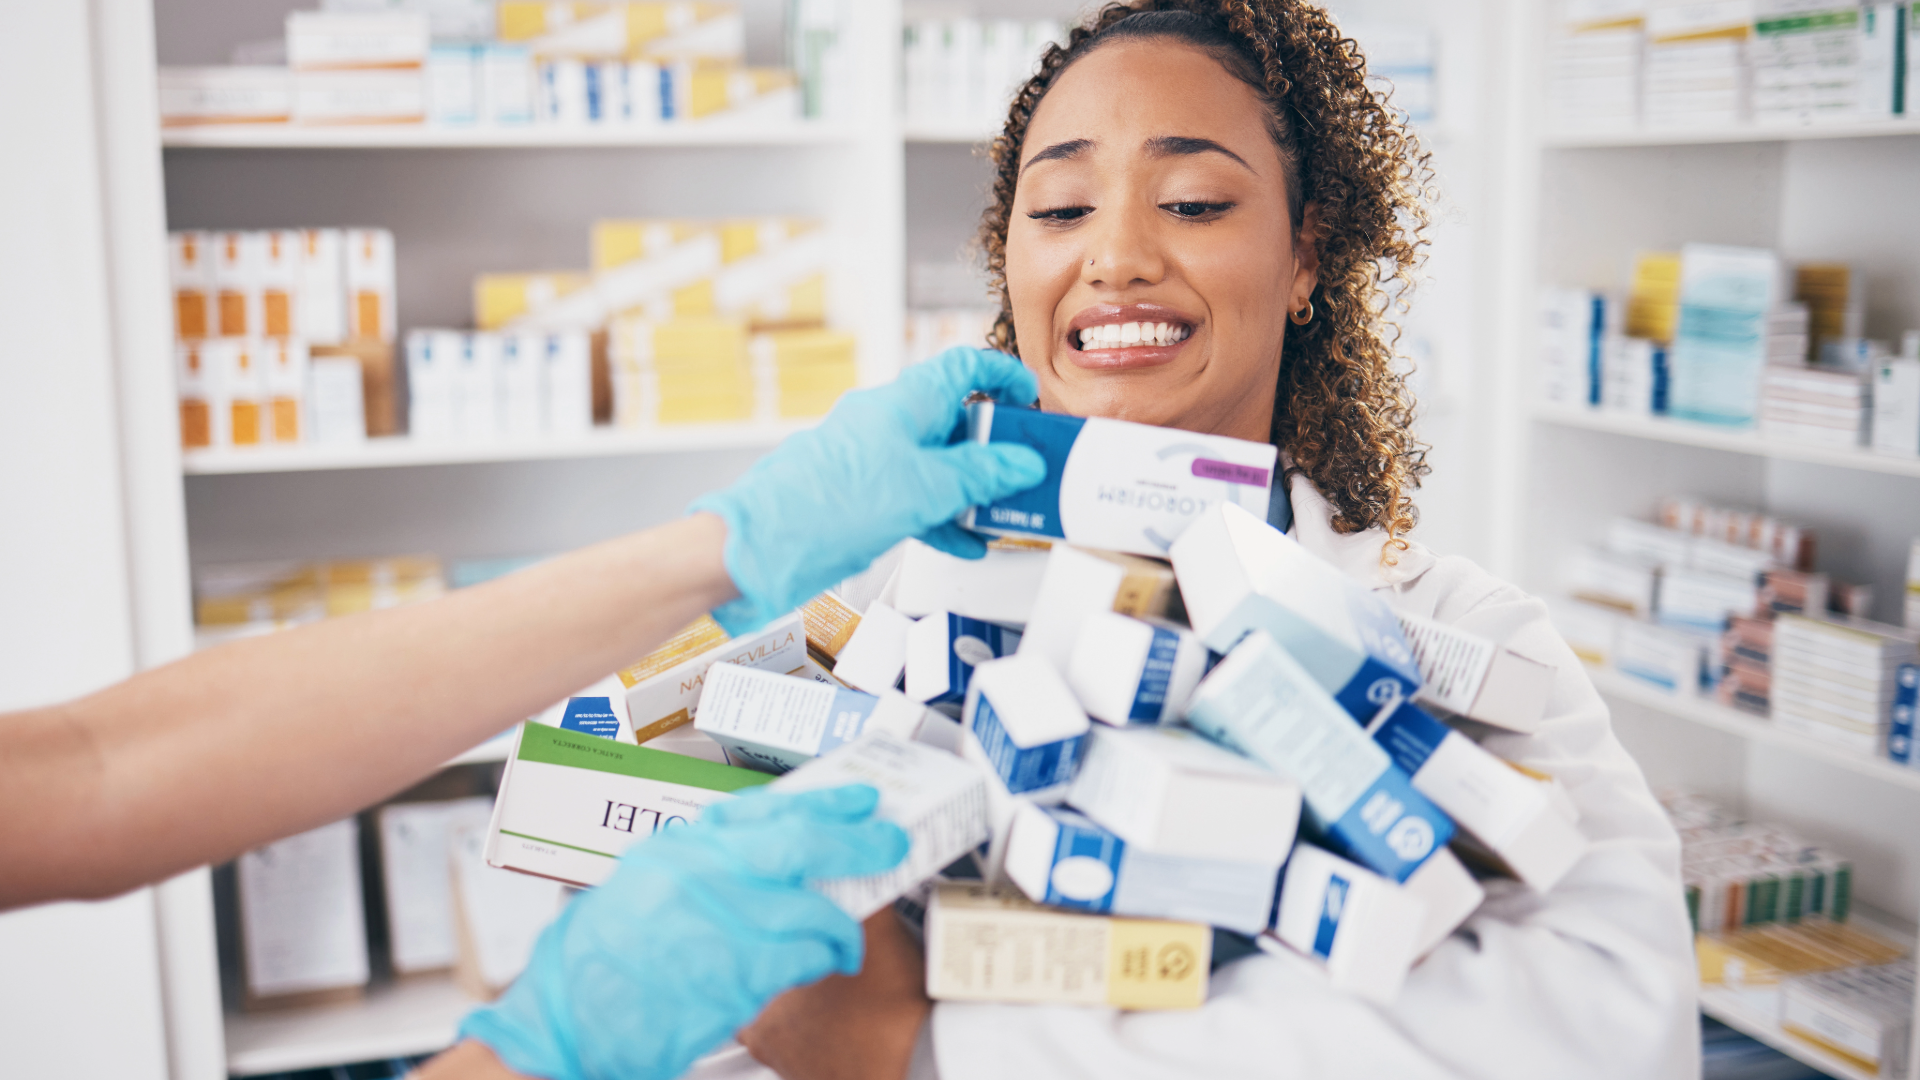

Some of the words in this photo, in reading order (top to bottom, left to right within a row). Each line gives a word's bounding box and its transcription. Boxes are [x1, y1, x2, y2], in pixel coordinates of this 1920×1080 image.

[1098, 485, 1208, 515] LOROFIRM
[990, 508, 1028, 527] TABLETS
[680, 632, 794, 695] NAREVILLA
[661, 715, 681, 729] aloe
[552, 739, 592, 754] CORRECTA
[593, 747, 624, 760] SEATICA
[600, 800, 694, 837] OLEI
